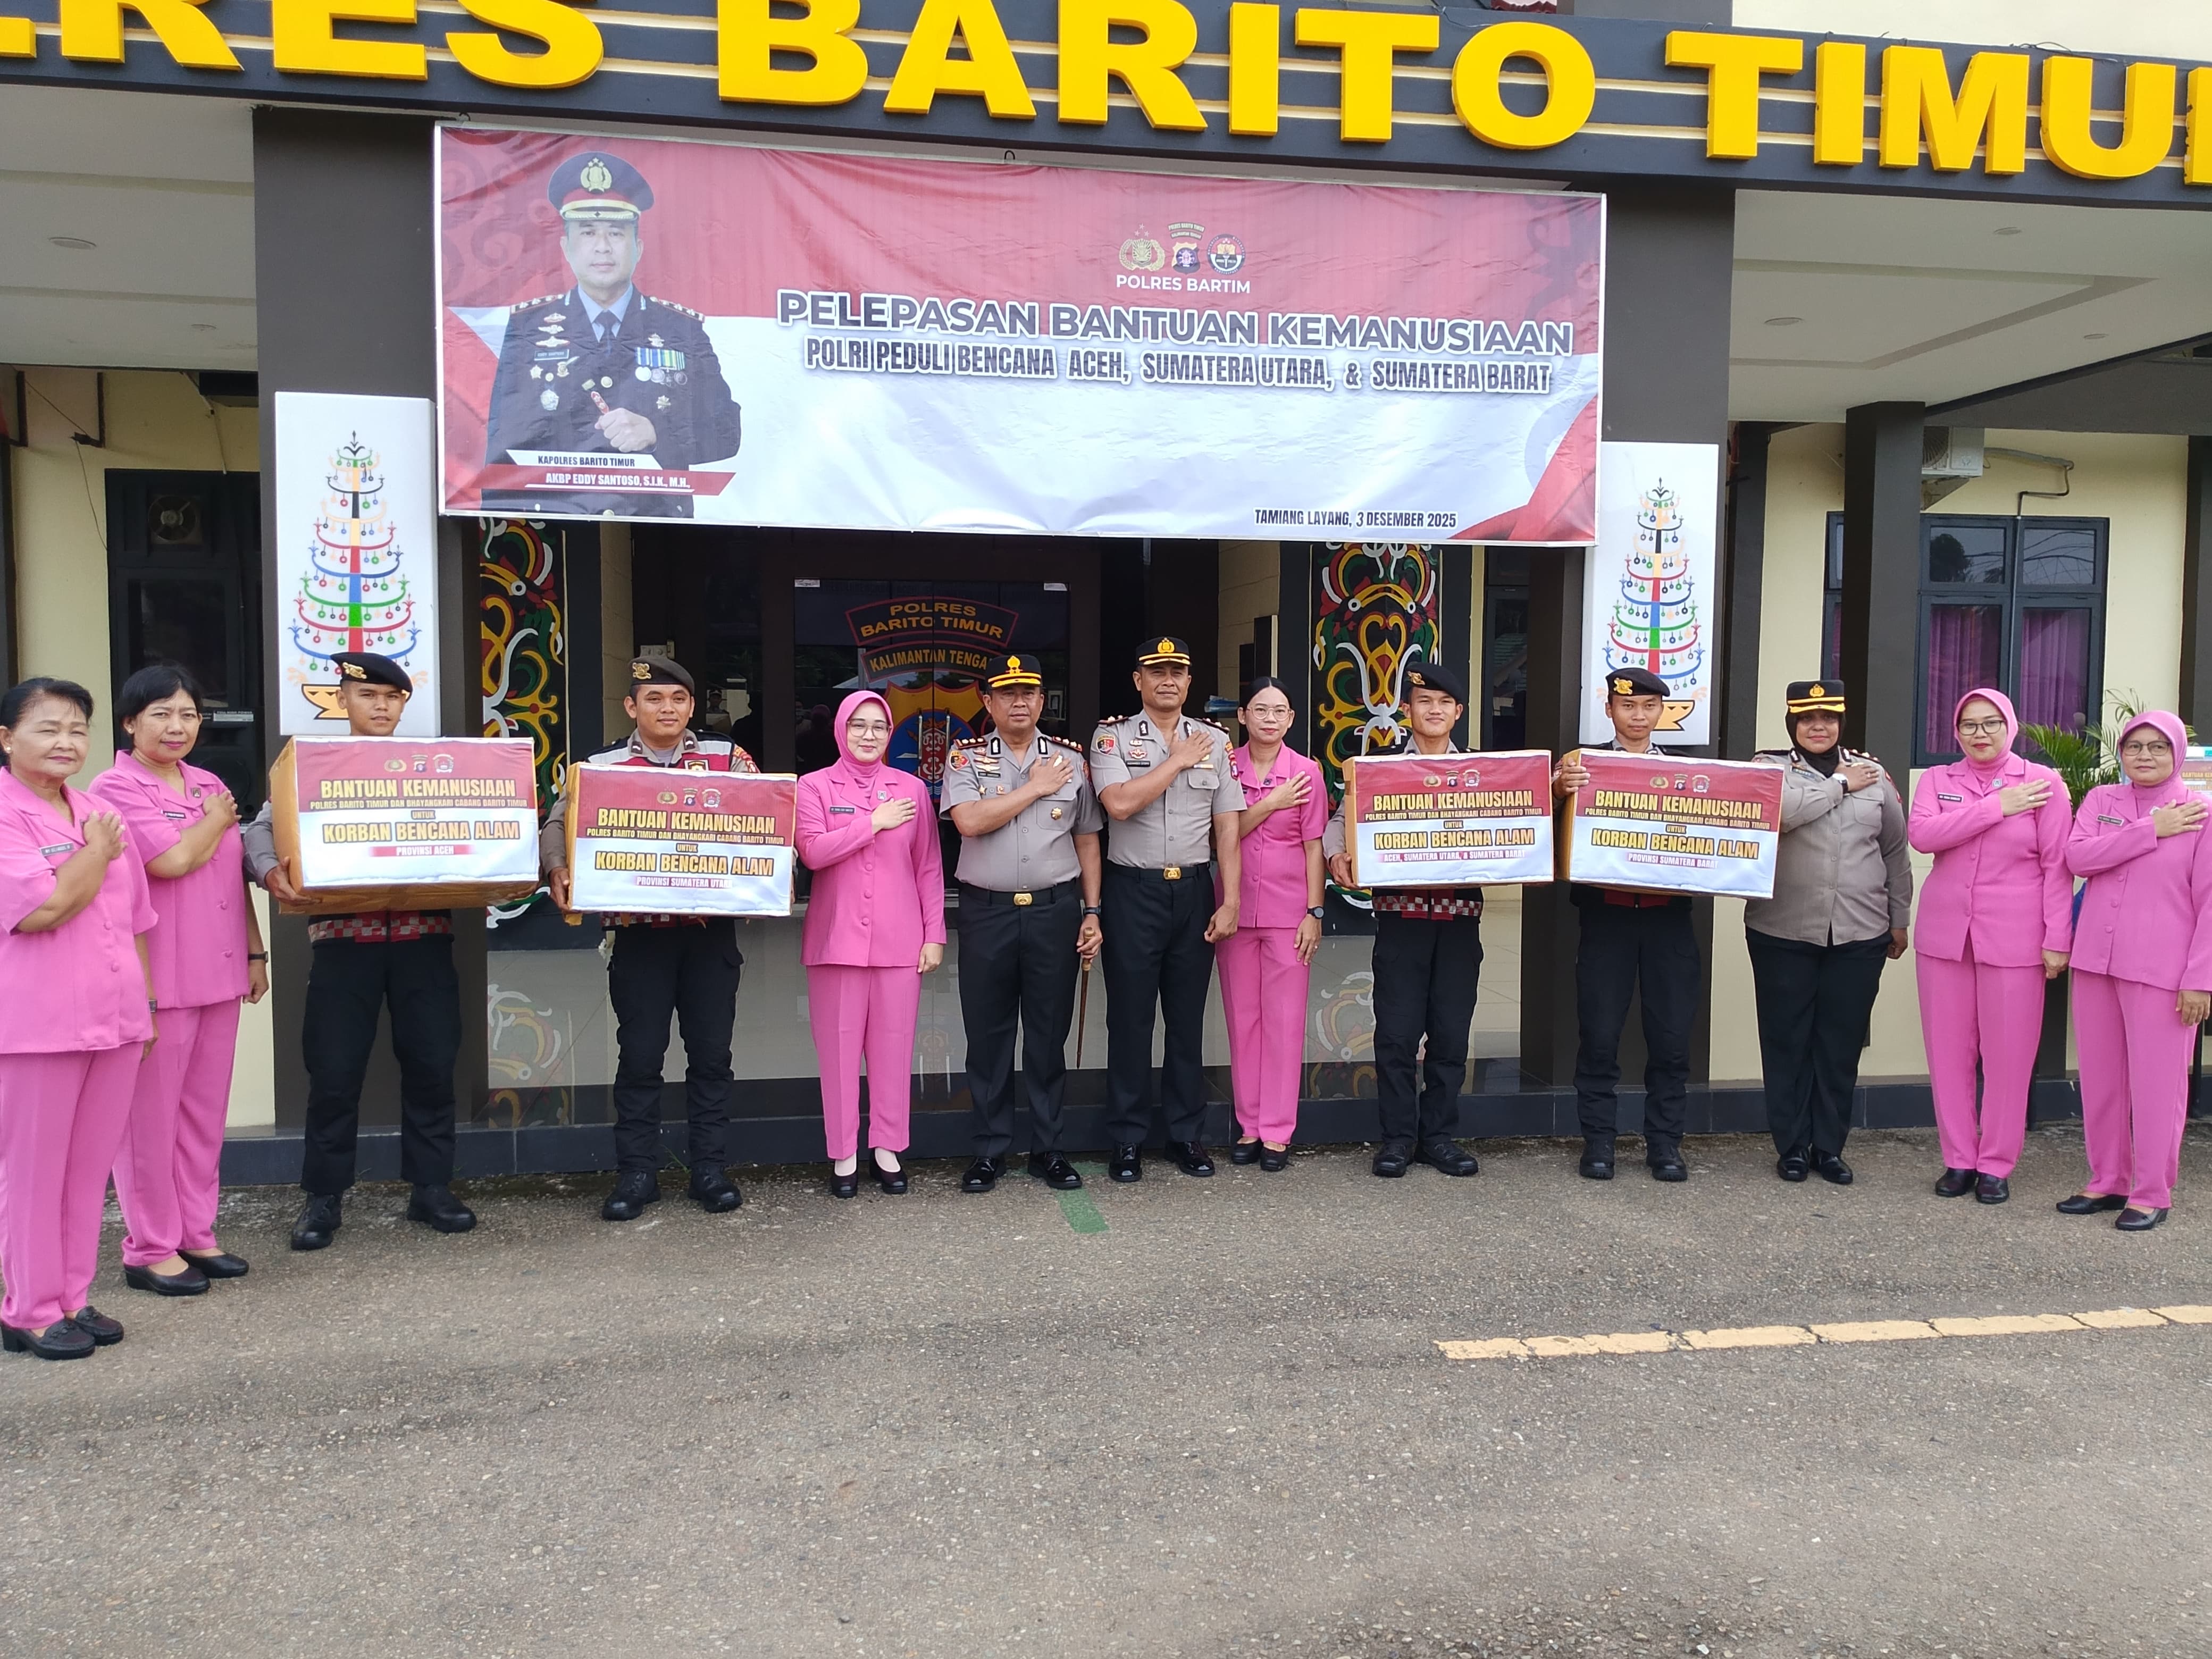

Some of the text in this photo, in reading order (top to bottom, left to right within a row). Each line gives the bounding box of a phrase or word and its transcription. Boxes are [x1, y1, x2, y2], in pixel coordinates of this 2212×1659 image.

[718, 0, 1596, 150] BARITO
[1665, 30, 2212, 186] TIMU
[1117, 274, 1250, 294] POLRES BARTIM
[779, 294, 1572, 354] PELEPASAN BANTUAN KEMANUSIAAN
[807, 338, 1551, 391] POLRI PEDULI BENCANA ACEH, SUMATERA UTARA, & SUMATERA BARAT
[538, 455, 635, 467] KAPOLRES BARITO TIMUR
[546, 472, 572, 485] AKBP
[572, 473, 597, 485] EDDY
[597, 474, 643, 488] SANTOSO,
[1254, 509, 1457, 528] TAMIANG LAYANG, 3 DESEMBER 2025
[890, 602, 977, 617] POLRES
[860, 616, 1004, 639] BARITO TIMUR
[869, 649, 992, 673] KALIMANTAN TENGA
[320, 778, 516, 799] BANTUAN KEMANUSIAAN
[310, 800, 338, 809] POLRES
[339, 800, 365, 809] BARITO
[366, 799, 389, 808] TIMUR
[390, 799, 405, 808] DAN
[455, 799, 482, 808] CABANG
[482, 799, 506, 808] BARITO
[506, 799, 528, 808] TIMUR
[1373, 790, 1533, 812] BANTUAN KEMANUSIAAN
[1595, 790, 1762, 819] BANTUAN KEMANUSIAAN
[412, 811, 435, 819] UNTUK
[597, 808, 775, 834] BANTUAN KEMANUSIAAN
[1364, 812, 1387, 821] POLRES
[1387, 812, 1407, 820] BARITO
[1407, 811, 1427, 819] TIMUR
[1479, 808, 1503, 817] CABANG
[1503, 808, 1524, 817] BARITO
[1524, 807, 1543, 816] TIMUR
[1585, 807, 1607, 816] POLRES
[1608, 809, 1629, 818] BARITO
[1630, 810, 1649, 819] TIMUR
[1649, 812, 1663, 821] DAN
[1704, 816, 1729, 827] CABANG
[1729, 819, 1751, 828] BARITO
[1751, 820, 1771, 831] TIMUR
[323, 822, 520, 843] KORBAN BENCANA ALAM
[1444, 820, 1464, 829] UNTUK
[1665, 824, 1687, 834] UNTUK
[586, 828, 611, 837] POLRES
[613, 829, 635, 839] BARITO
[636, 830, 657, 839] TIMUR
[658, 831, 672, 840] DAN
[717, 834, 741, 843] CABANG
[742, 834, 764, 844] BARITO
[765, 835, 785, 845] TIMUR
[1375, 828, 1535, 850] KORBAN BENCANA ALAM
[1591, 828, 1760, 860] KORBAN BENCANA ALAM
[396, 845, 455, 856] PROVINSI ACEH
[676, 843, 699, 852] UNTUK
[1403, 852, 1439, 862] SUMATERA
[1469, 850, 1504, 860] SUMATERA
[1504, 849, 1526, 859] BARAT
[595, 852, 774, 876] KORBAN BENCANA ALAM
[1628, 853, 1719, 868] PROVINSI SUMATERA BARAT
[636, 876, 670, 886] PROVINSI
[671, 877, 709, 888] SUMATERA
